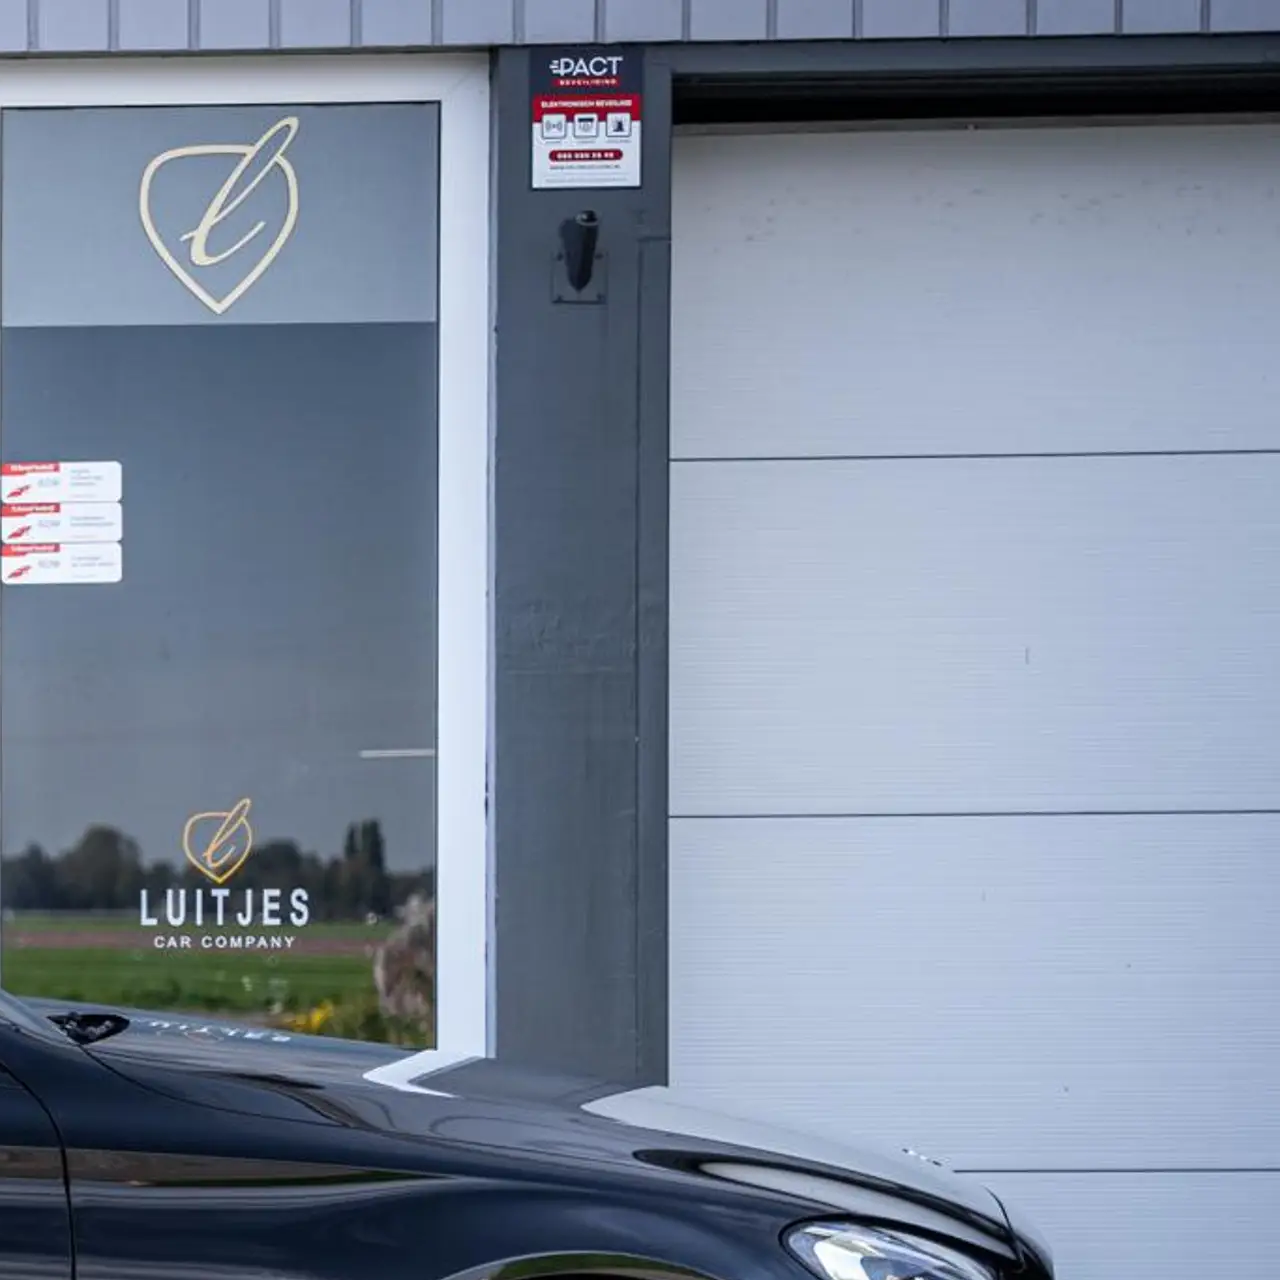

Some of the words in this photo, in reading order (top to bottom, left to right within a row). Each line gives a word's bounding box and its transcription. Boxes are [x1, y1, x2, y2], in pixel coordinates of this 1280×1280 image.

[140, 887, 309, 926] LUITJES
[153, 935, 192, 949] CAR
[201, 935, 295, 949] COMPANY
